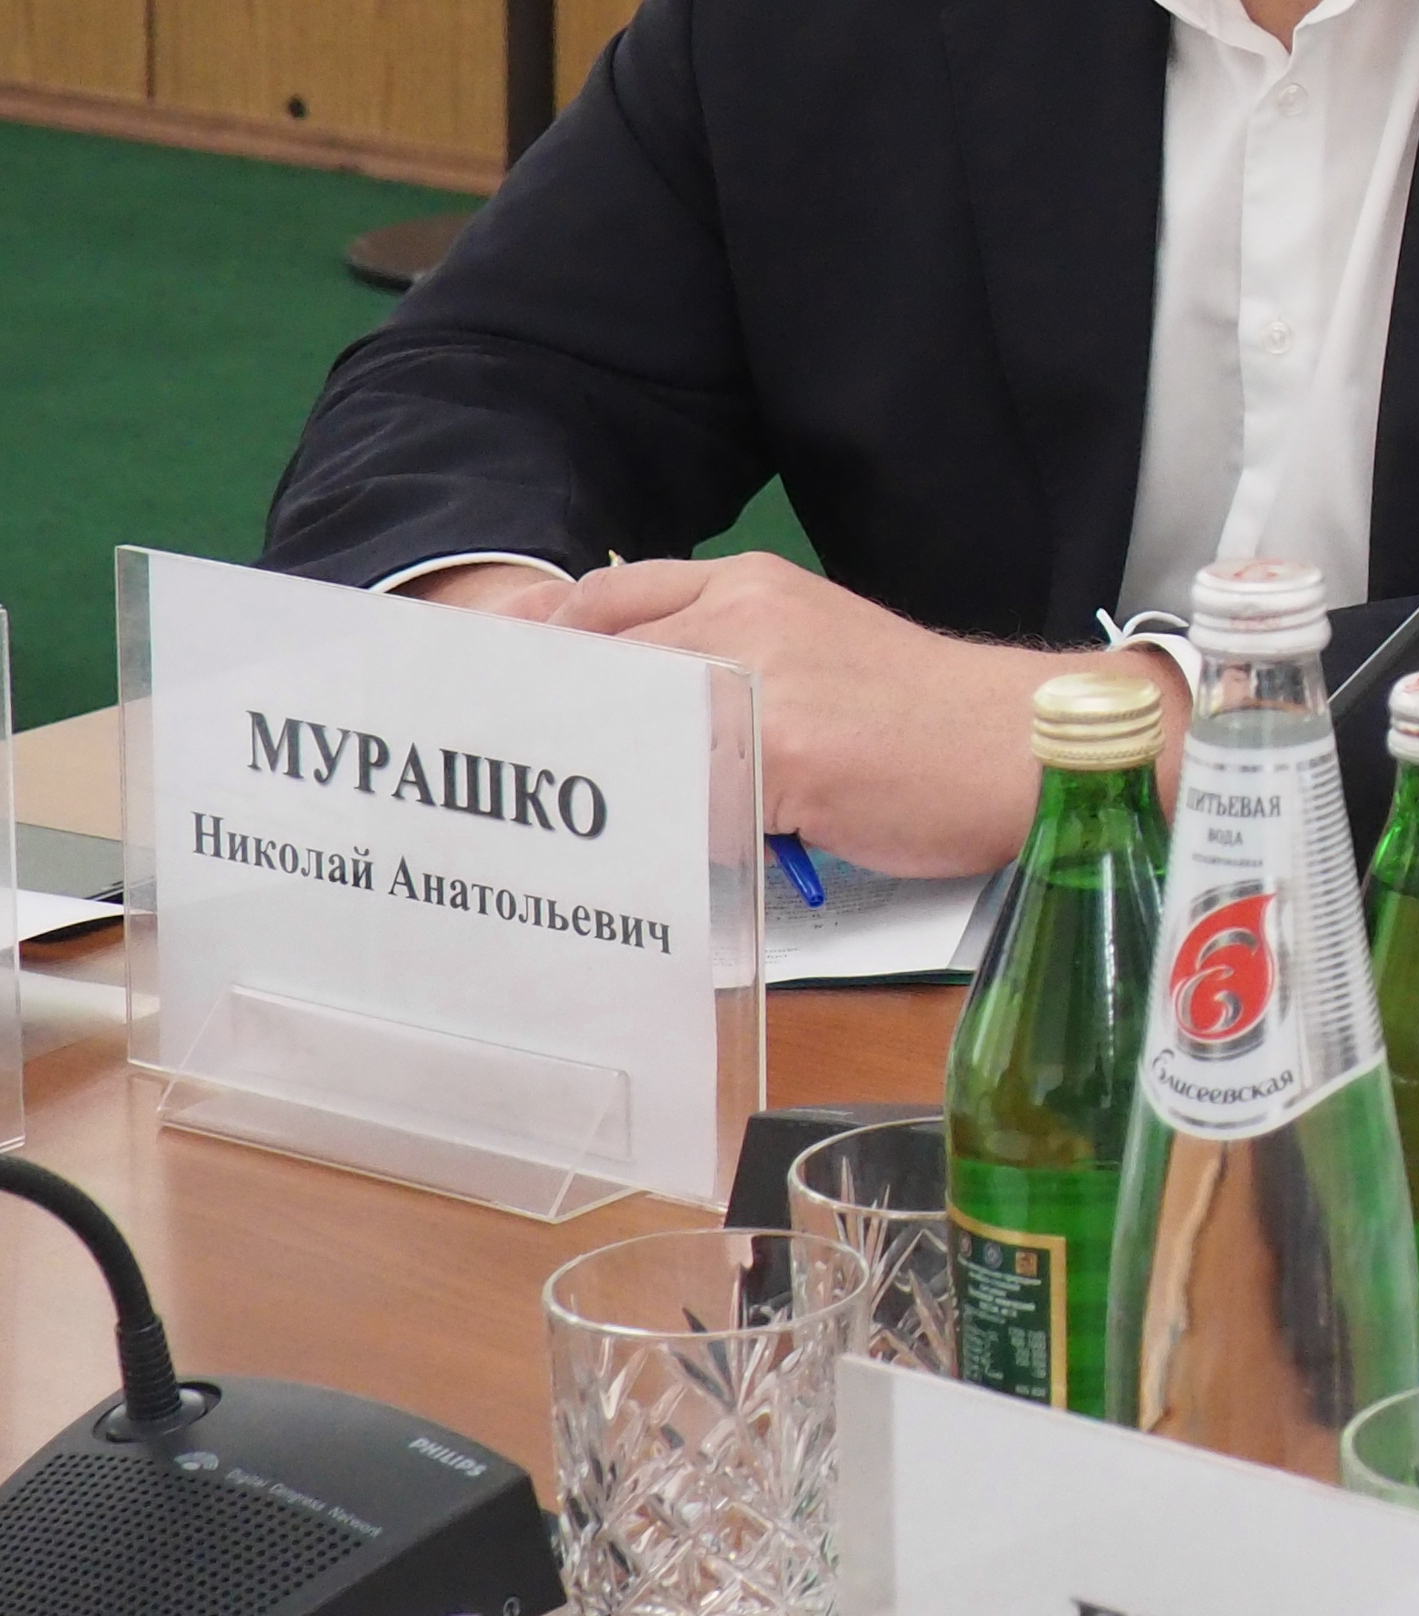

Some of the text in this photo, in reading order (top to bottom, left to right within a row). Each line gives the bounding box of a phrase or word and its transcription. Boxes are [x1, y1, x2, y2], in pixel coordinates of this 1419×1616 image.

[245, 709, 608, 841] МУРАШКО
[1186, 786, 1281, 818] ПИТЬЕВАЯ
[192, 811, 374, 892] Николай
[389, 856, 673, 955] Анатольевич
[1152, 1048, 1295, 1106] Елисеевская
[407, 1437, 488, 1478] PHILIPS
